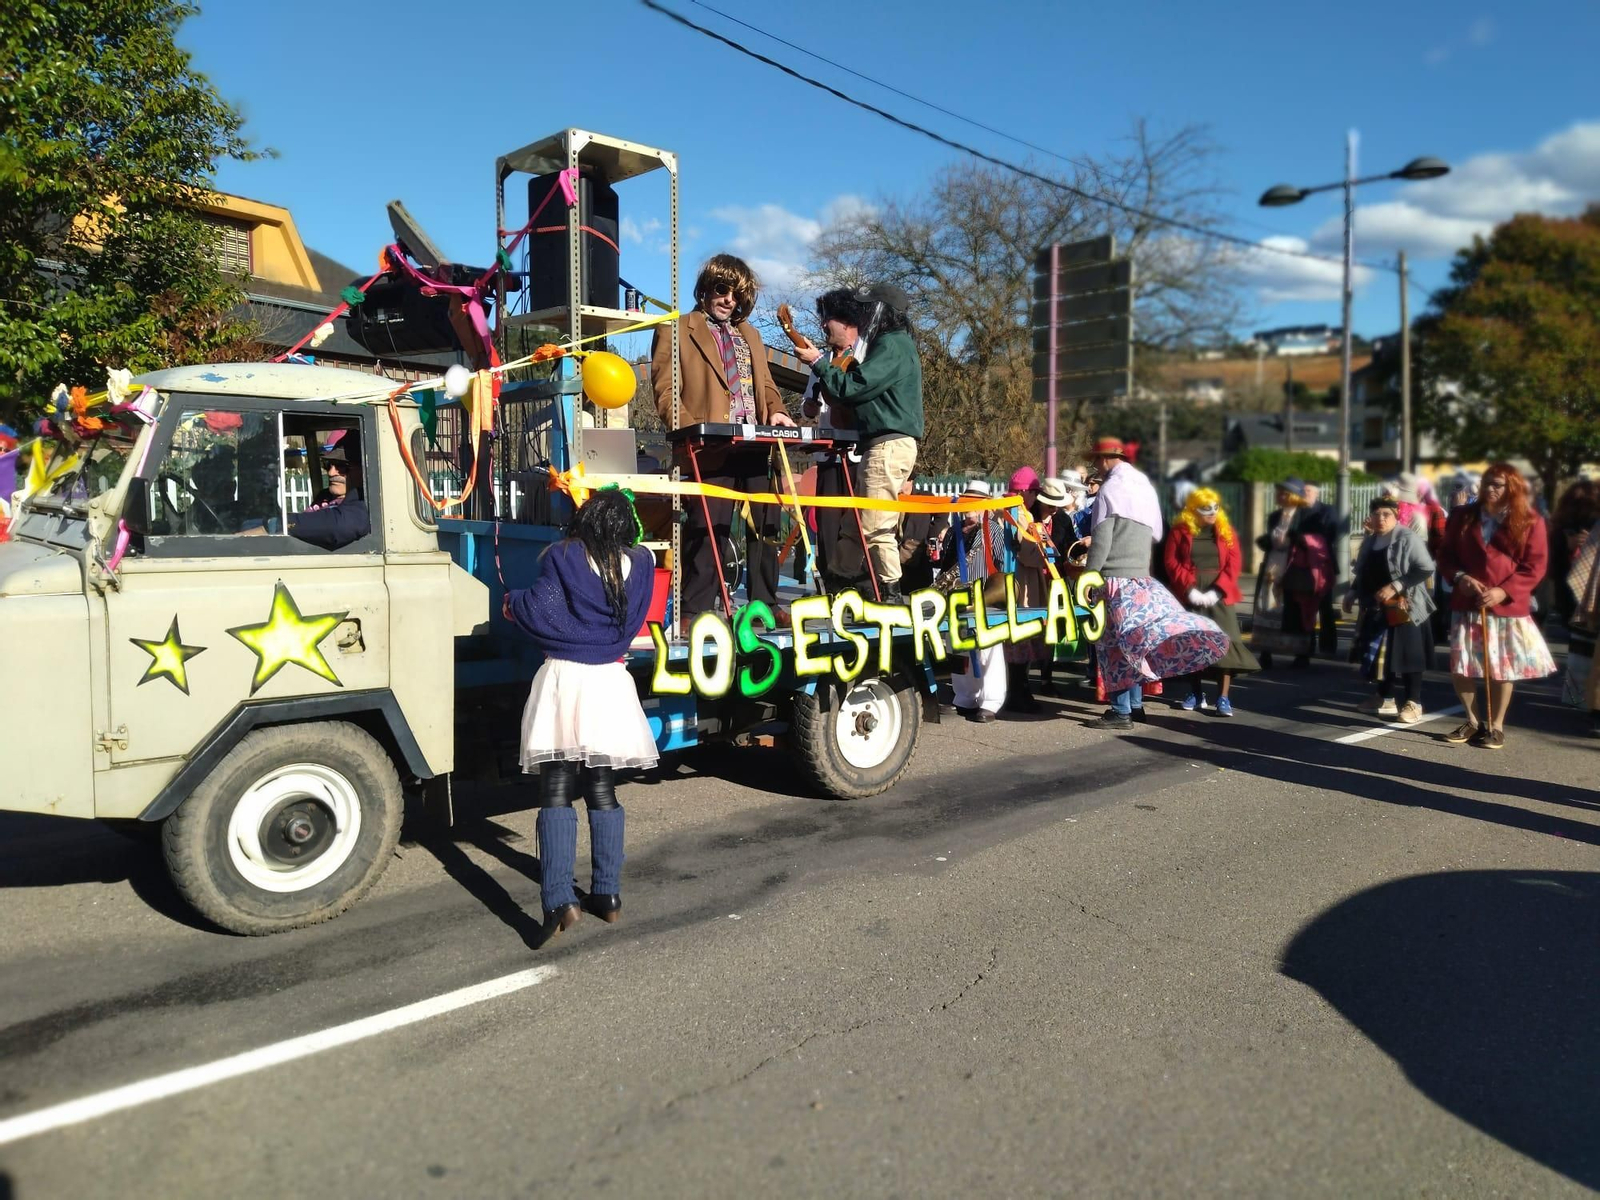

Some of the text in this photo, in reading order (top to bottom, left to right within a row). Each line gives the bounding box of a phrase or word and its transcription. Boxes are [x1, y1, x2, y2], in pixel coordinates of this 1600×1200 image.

[771, 429, 799, 438] CASIO
[648, 570, 1106, 698] LOS ESTRELLAS
